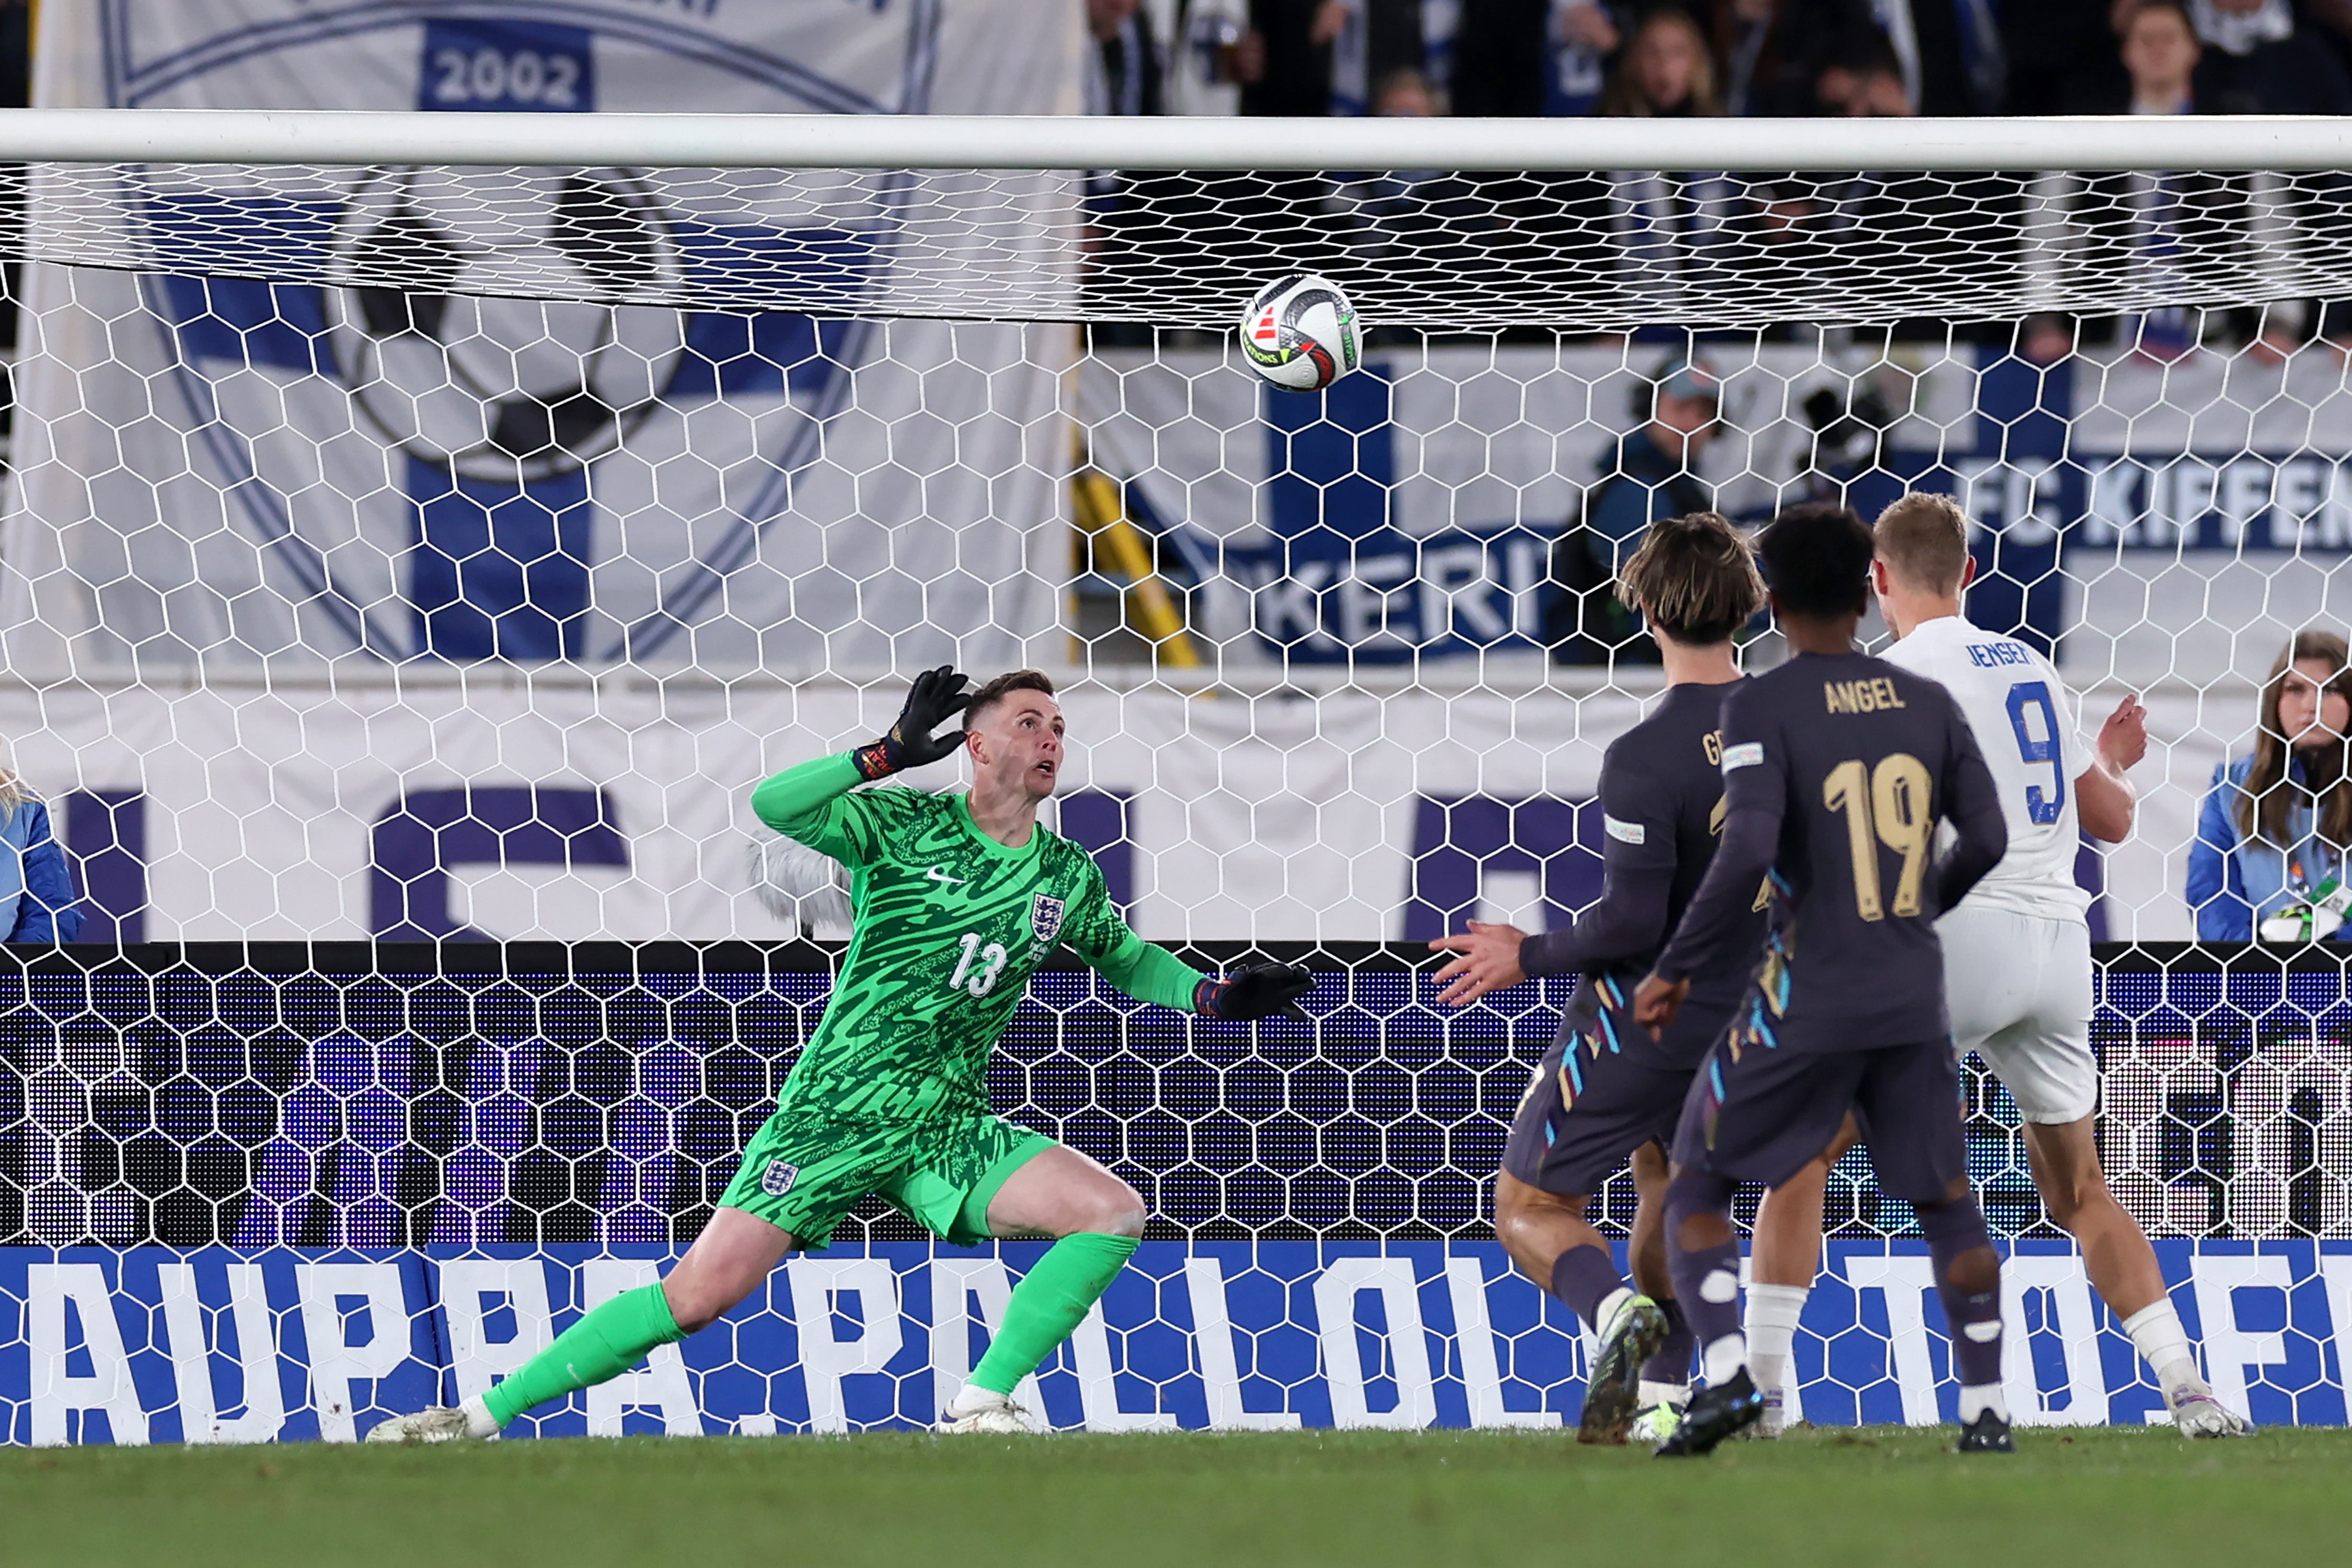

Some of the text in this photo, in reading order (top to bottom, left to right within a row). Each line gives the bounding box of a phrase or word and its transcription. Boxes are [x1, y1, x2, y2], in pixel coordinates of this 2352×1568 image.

[433, 48, 579, 103] 2002
[1955, 459, 2061, 545] FC
[1824, 678, 1907, 714] ANGEL
[2005, 681, 2065, 826] 9
[1823, 753, 1933, 922] 19
[949, 932, 1007, 998] 13
